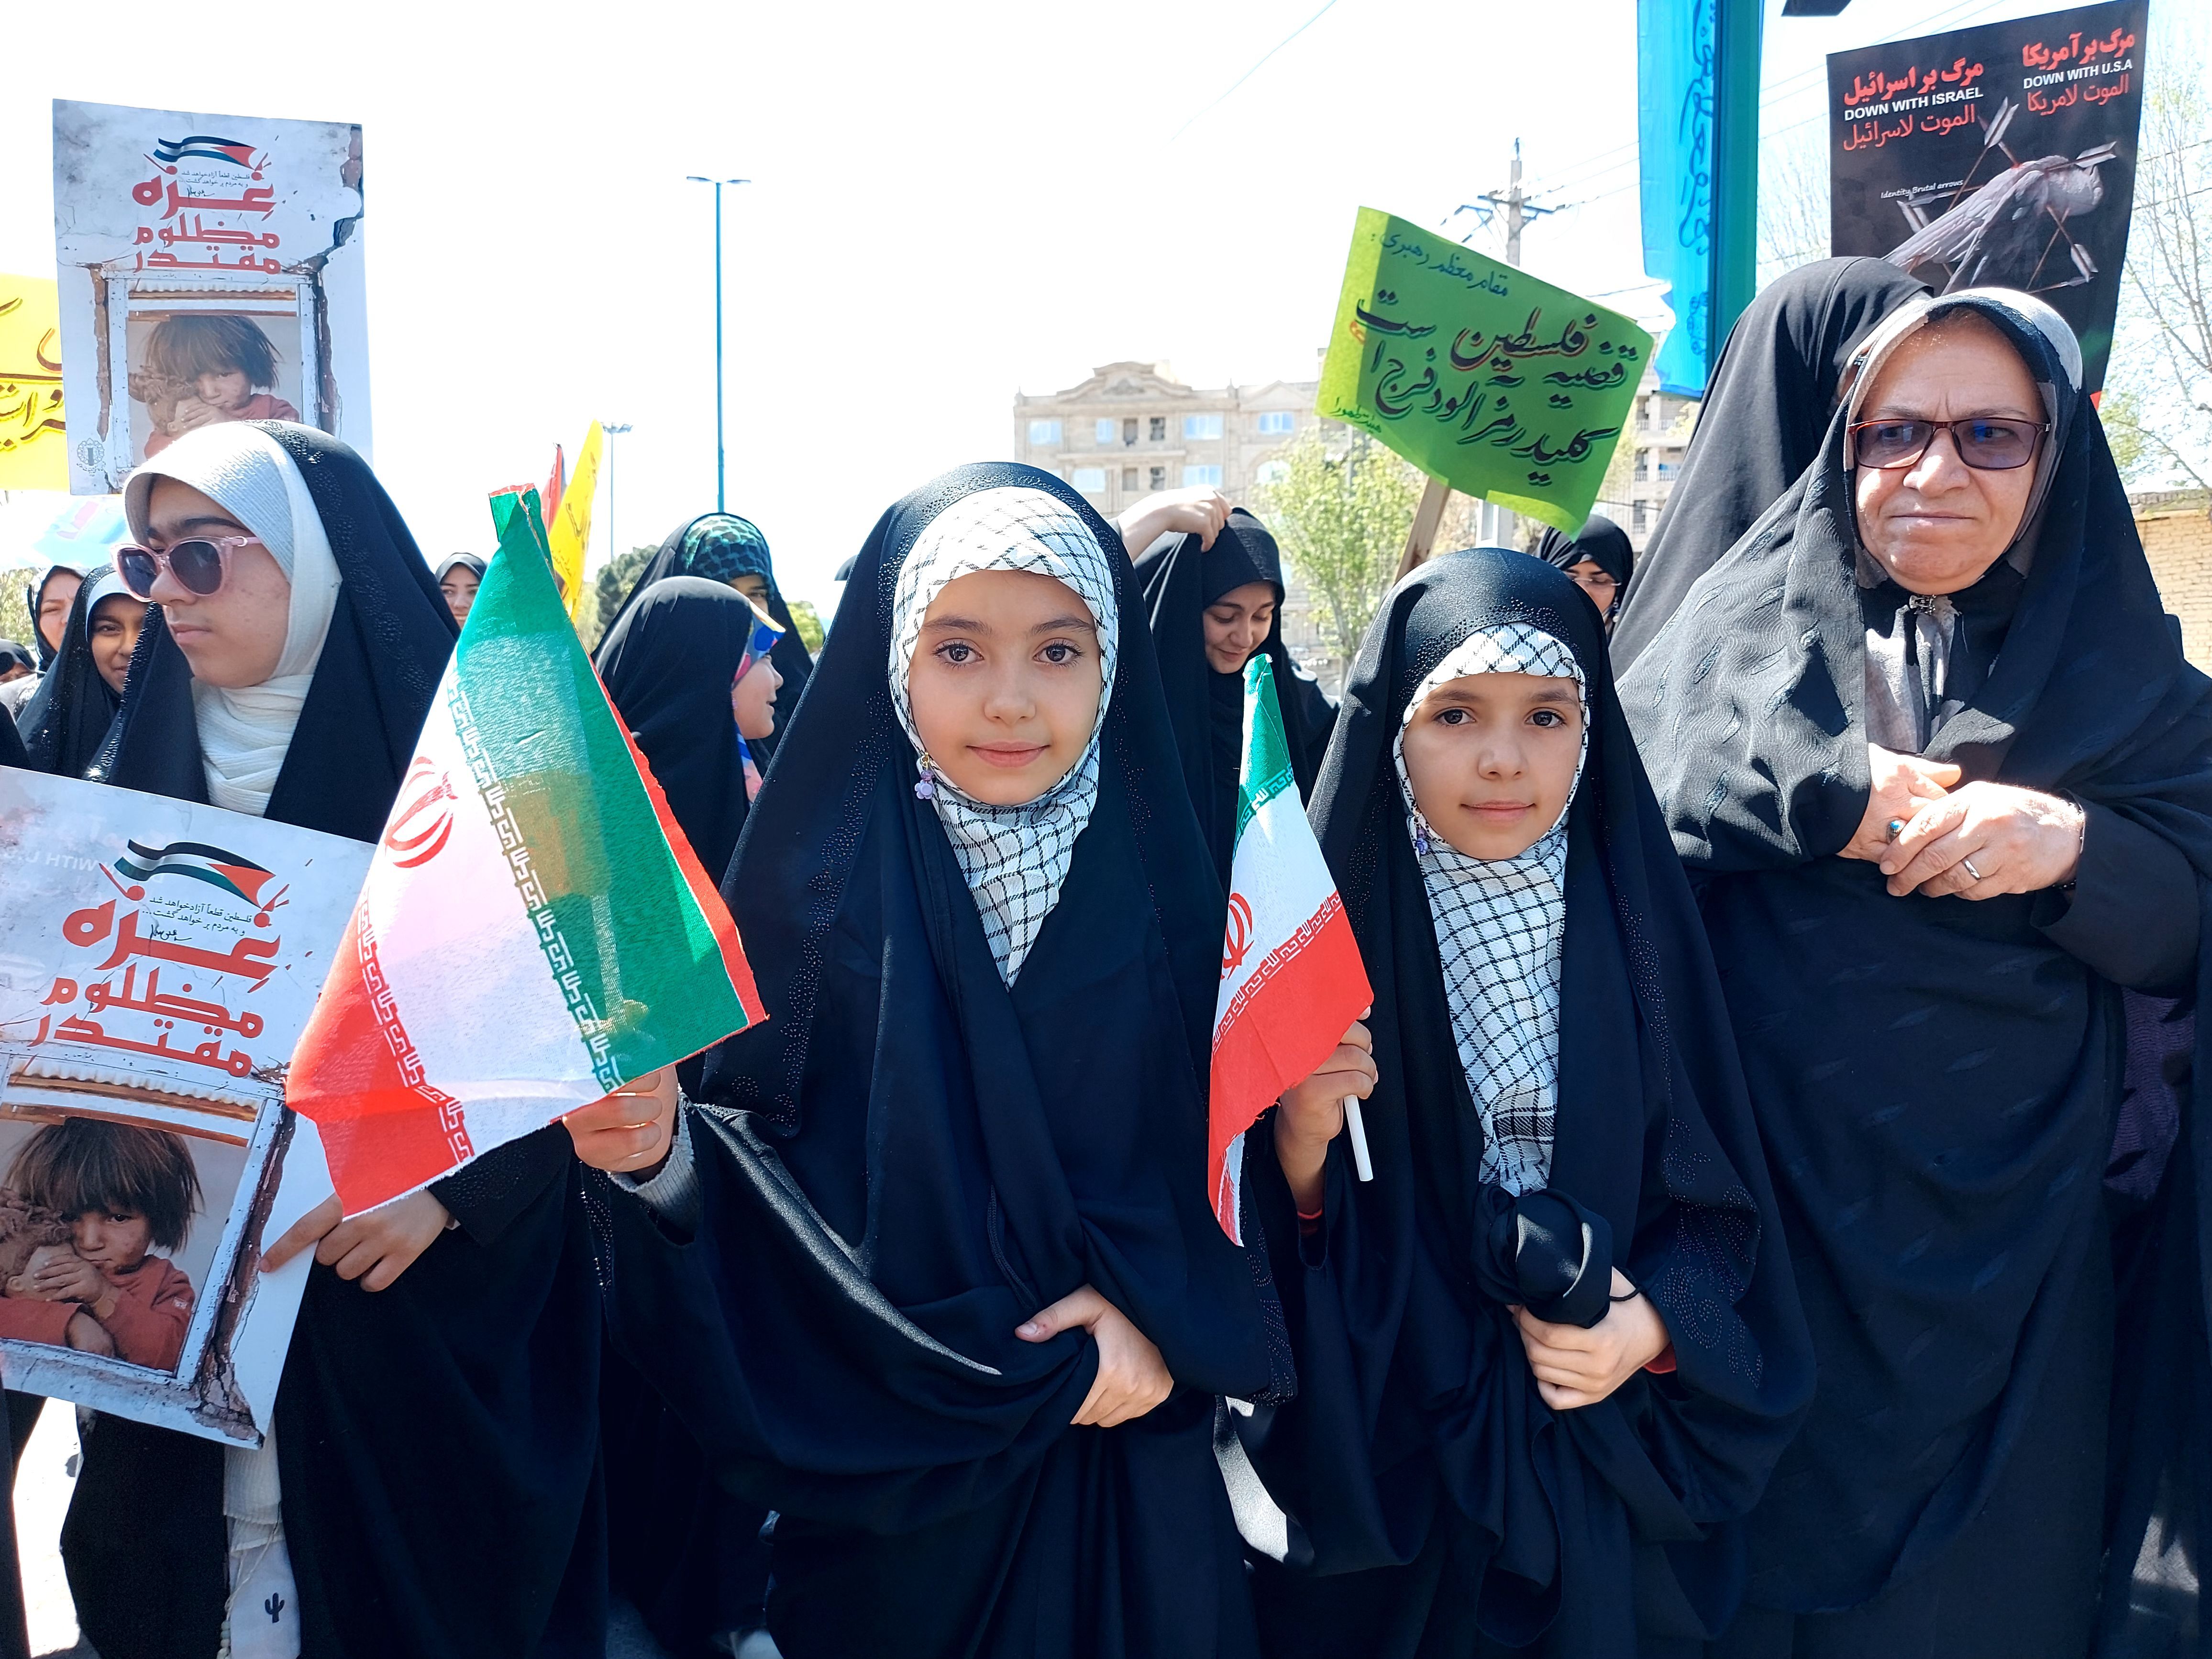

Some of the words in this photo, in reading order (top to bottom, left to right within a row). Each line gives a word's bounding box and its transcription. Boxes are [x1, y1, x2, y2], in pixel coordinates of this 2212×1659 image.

[2023, 32, 2082, 70] آمریکا
[2079, 39, 2097, 65] بر
[2100, 27, 2135, 58] مرگ
[1844, 66, 1916, 105] اسرائیل
[1917, 69, 1937, 94] بر
[1941, 57, 1984, 87] مرگ
[2024, 72, 2064, 89] DOWN
[2067, 65, 2100, 81] WITH
[2102, 58, 2133, 74] U.S.A
[1845, 103, 1889, 121] DOWN
[1892, 96, 1929, 112] WITH
[1932, 87, 1984, 105] ISRAEL
[2083, 73, 2129, 106] الموت
[1921, 103, 1975, 136] الموت
[132, 158, 277, 221] غزه
[1880, 188, 1911, 199] Identity
[1912, 182, 1936, 194] Brutal
[1937, 180, 1964, 189] arrows
[133, 212, 280, 249] مظلوم
[133, 245, 281, 275] مقتدر
[1466, 270, 1508, 297] مقام
[1449, 306, 1598, 372] فلسطین
[165, 900, 190, 911] خواهد
[177, 914, 202, 926] خواهد
[189, 903, 205, 914] آزاد
[224, 912, 253, 923] فلسطین
[63, 871, 281, 993] غزه
[212, 923, 229, 931] مردم
[40, 962, 264, 1039] مظلوم
[27, 1014, 253, 1078] مقتدر
